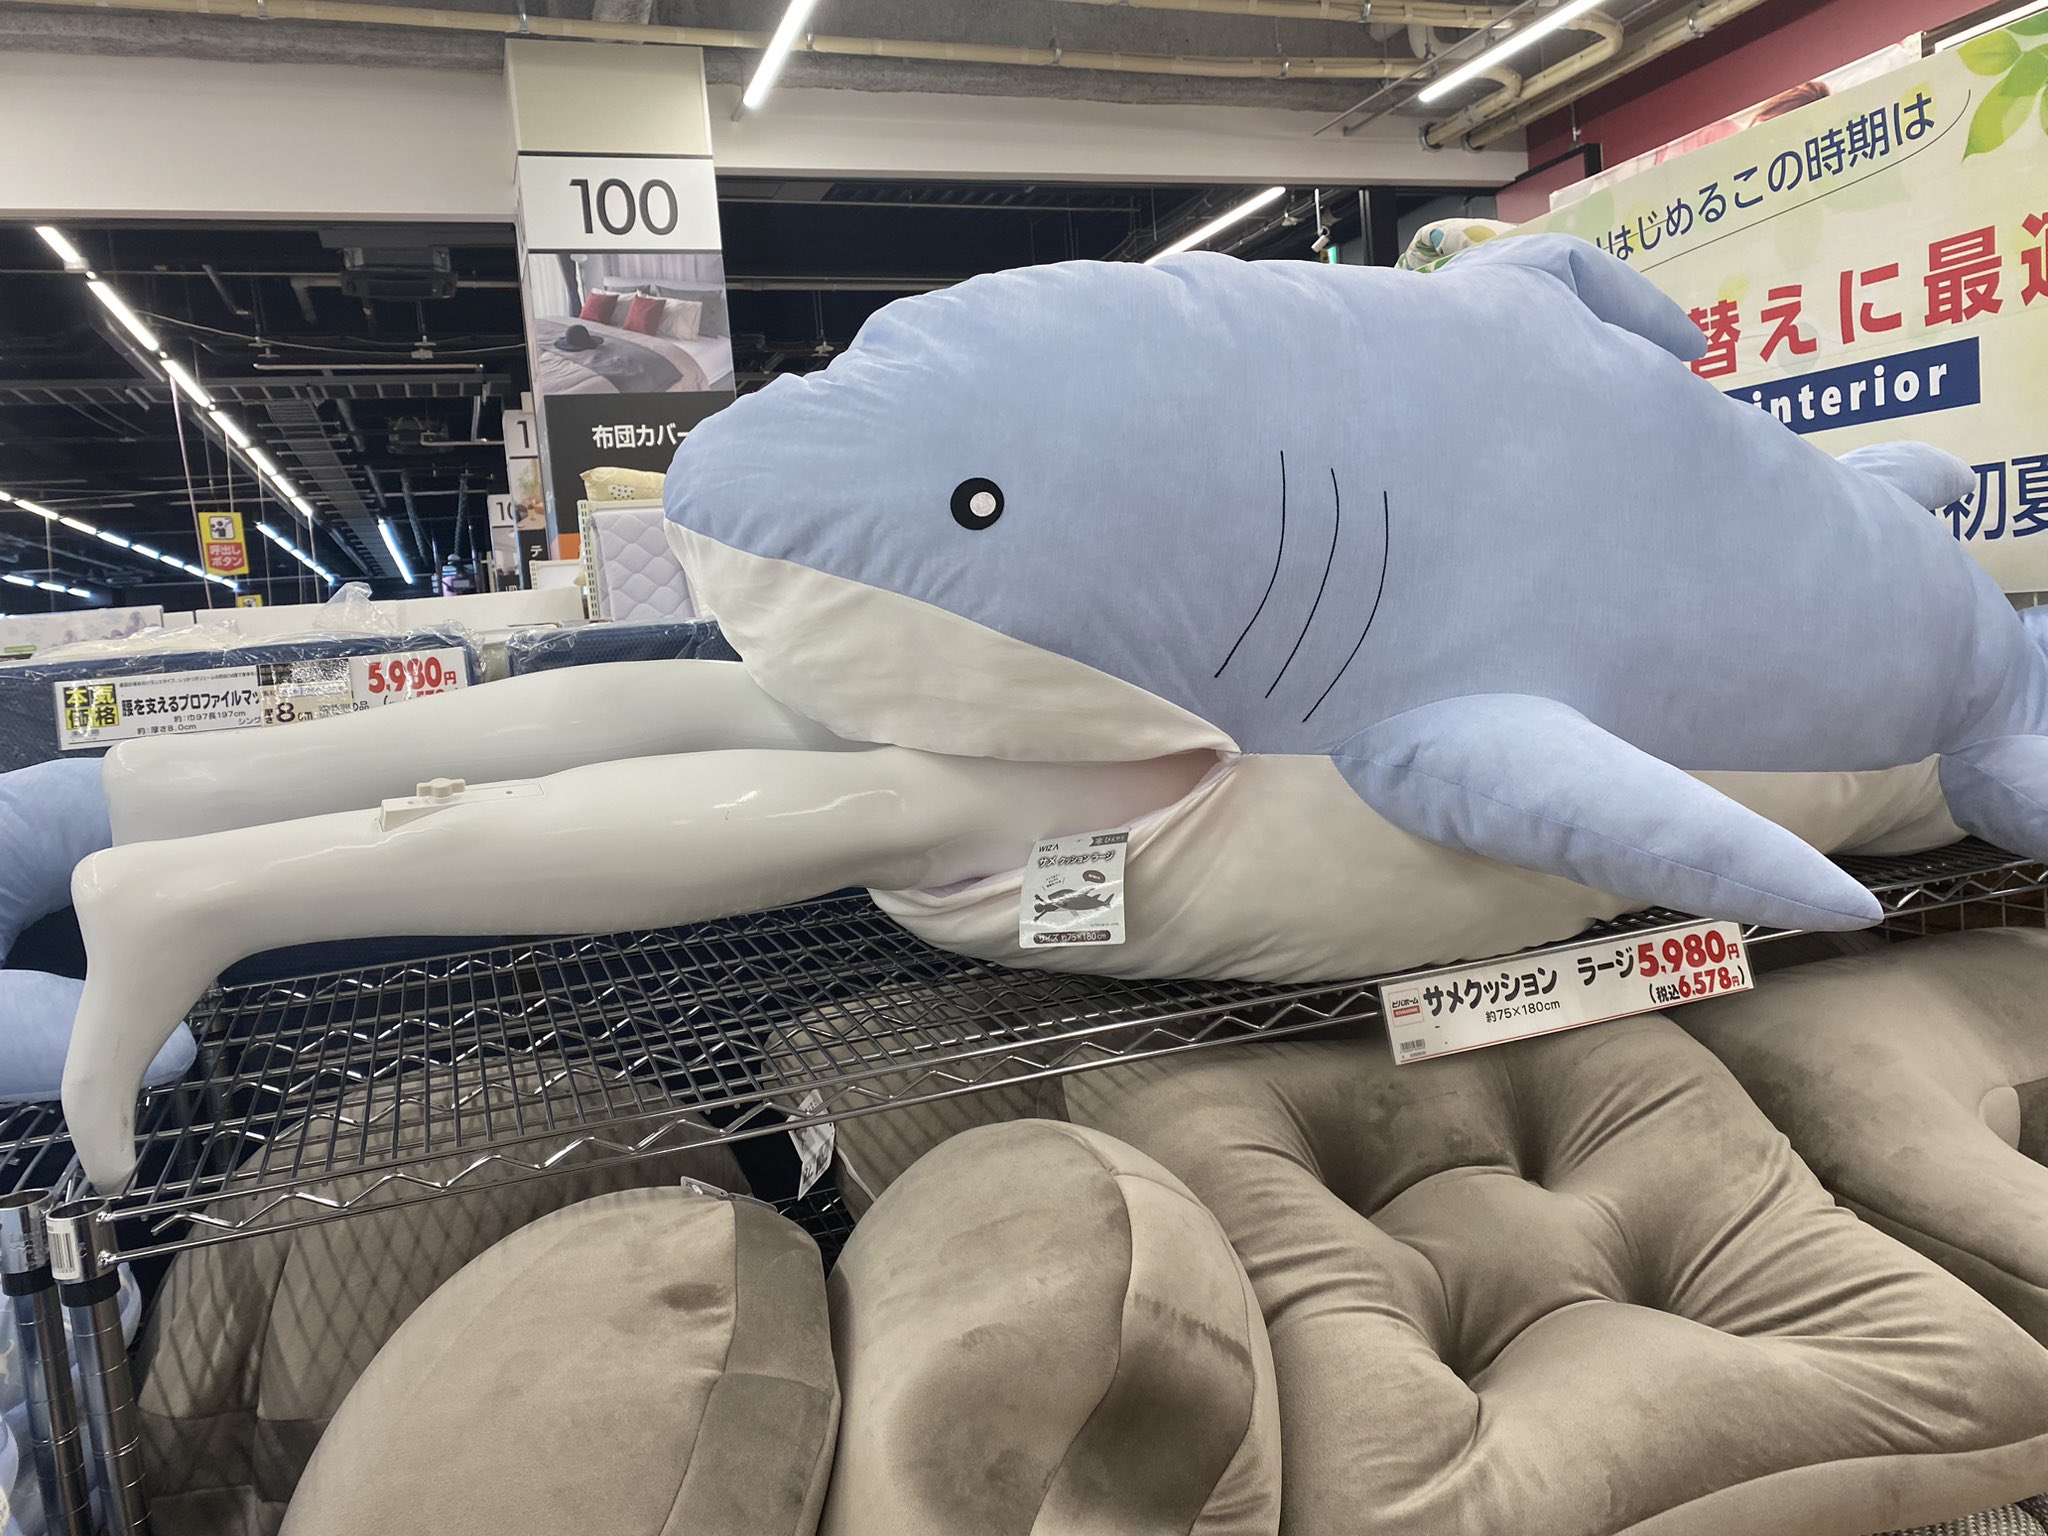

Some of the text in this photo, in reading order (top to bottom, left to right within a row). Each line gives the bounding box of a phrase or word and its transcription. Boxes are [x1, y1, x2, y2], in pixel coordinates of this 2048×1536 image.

[1596, 92, 1936, 261] はじめるこの時期は
[569, 178, 679, 236] 100
[591, 422, 689, 449] 布団カバー
[1929, 453, 2048, 542] 初夏
[209, 544, 241, 556] 呼出し
[211, 556, 243, 567] ボタン
[368, 656, 457, 694] 5,980円
[1637, 930, 1740, 978] 5,980円
[1423, 947, 1634, 1017] サメクッション ラージ
[1485, 1000, 1561, 1023] 約75×180cm
